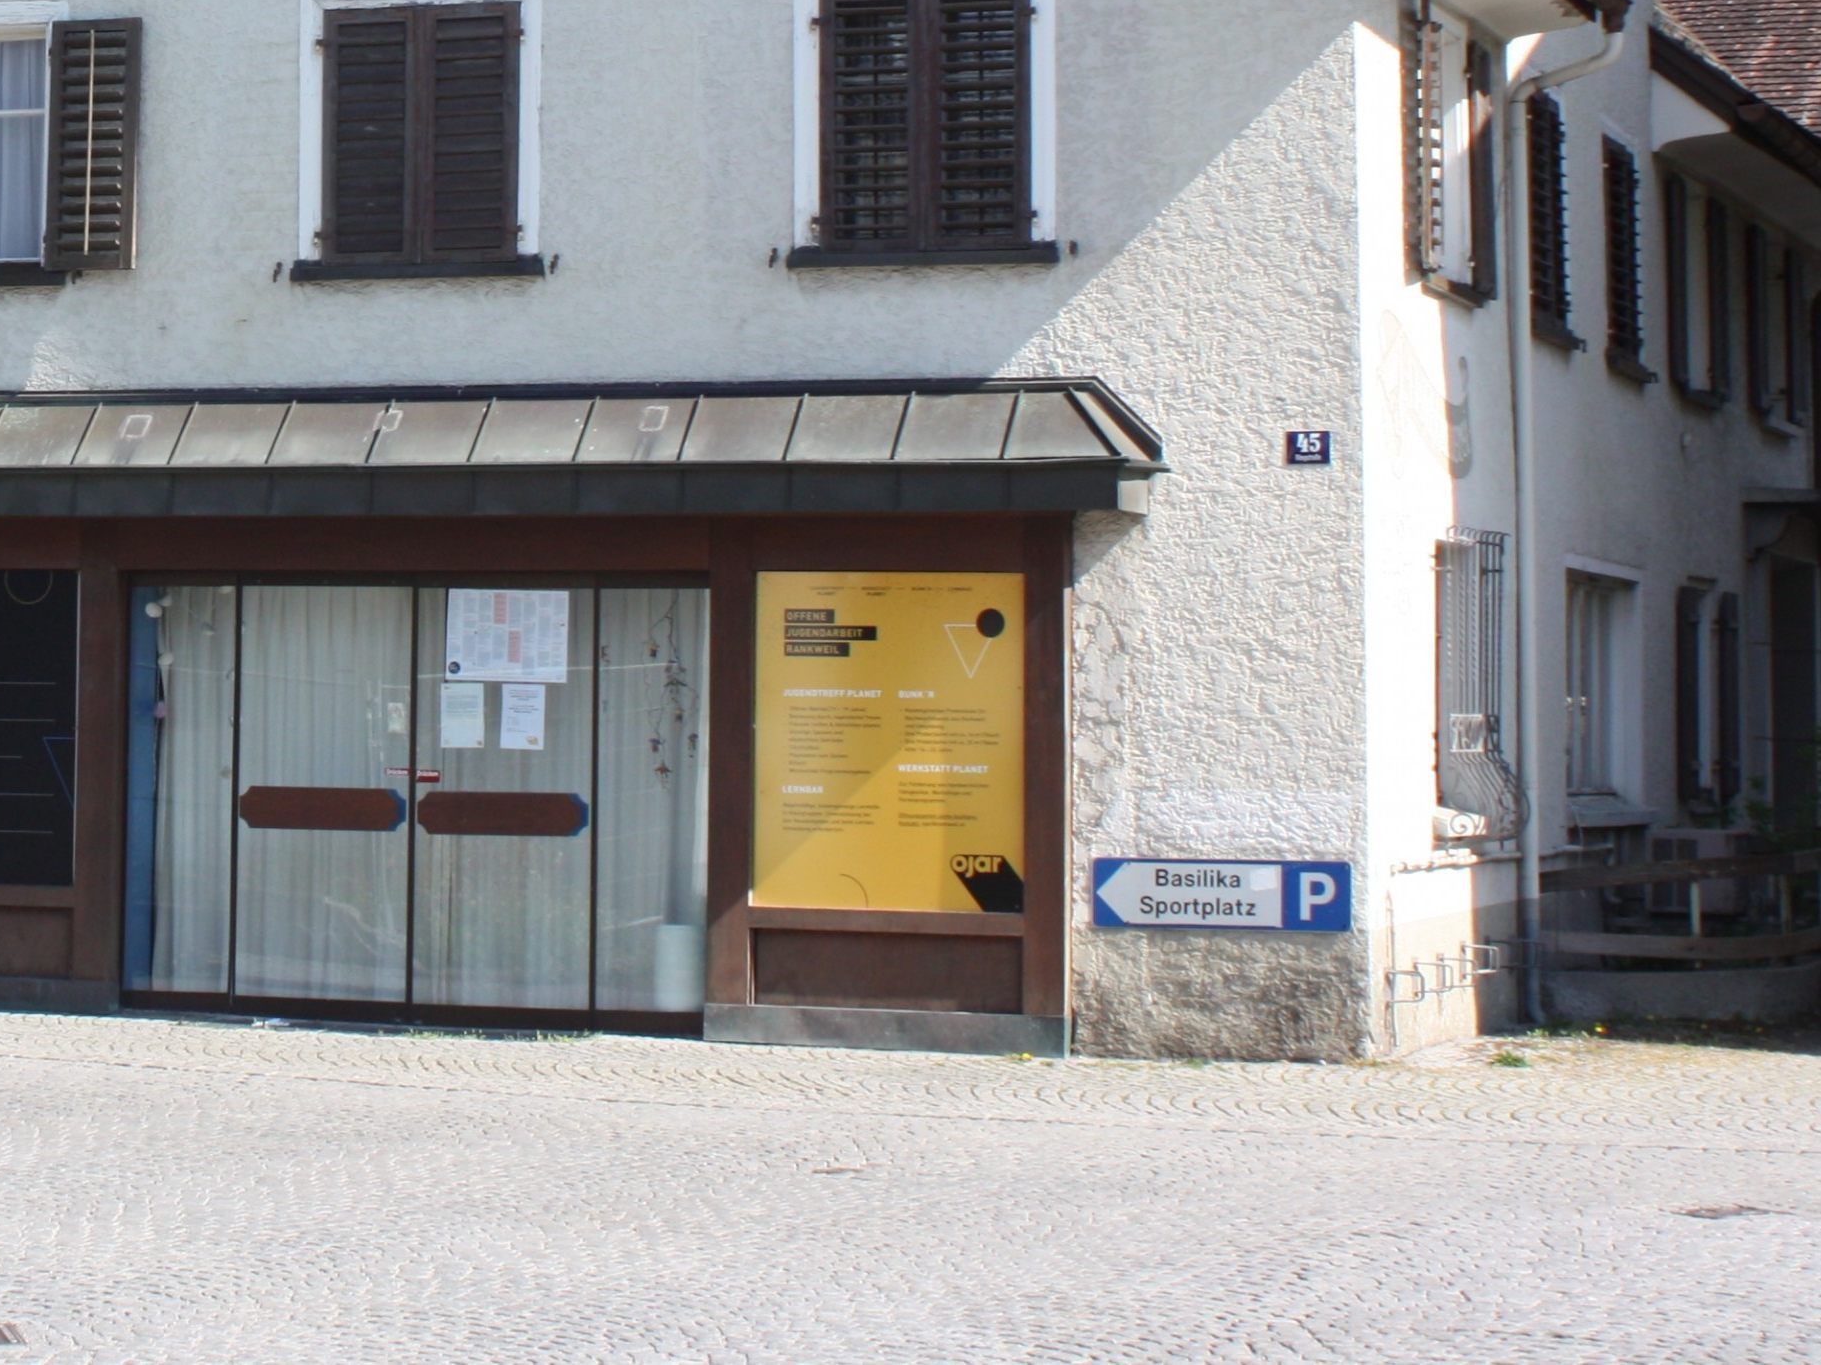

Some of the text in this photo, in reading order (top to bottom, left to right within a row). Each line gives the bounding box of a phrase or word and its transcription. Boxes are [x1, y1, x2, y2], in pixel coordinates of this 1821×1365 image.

[1296, 433, 1321, 453] 45
[786, 611, 827, 621] OFFENE
[786, 628, 863, 638] JUGENDARBEIT
[786, 644, 840, 654] RANKWEIL
[846, 690, 883, 698] PLANET
[951, 854, 1002, 878] ojar
[1155, 868, 1241, 888] Basilika
[1298, 871, 1337, 922] P
[1140, 896, 1257, 920] Sportplatz
